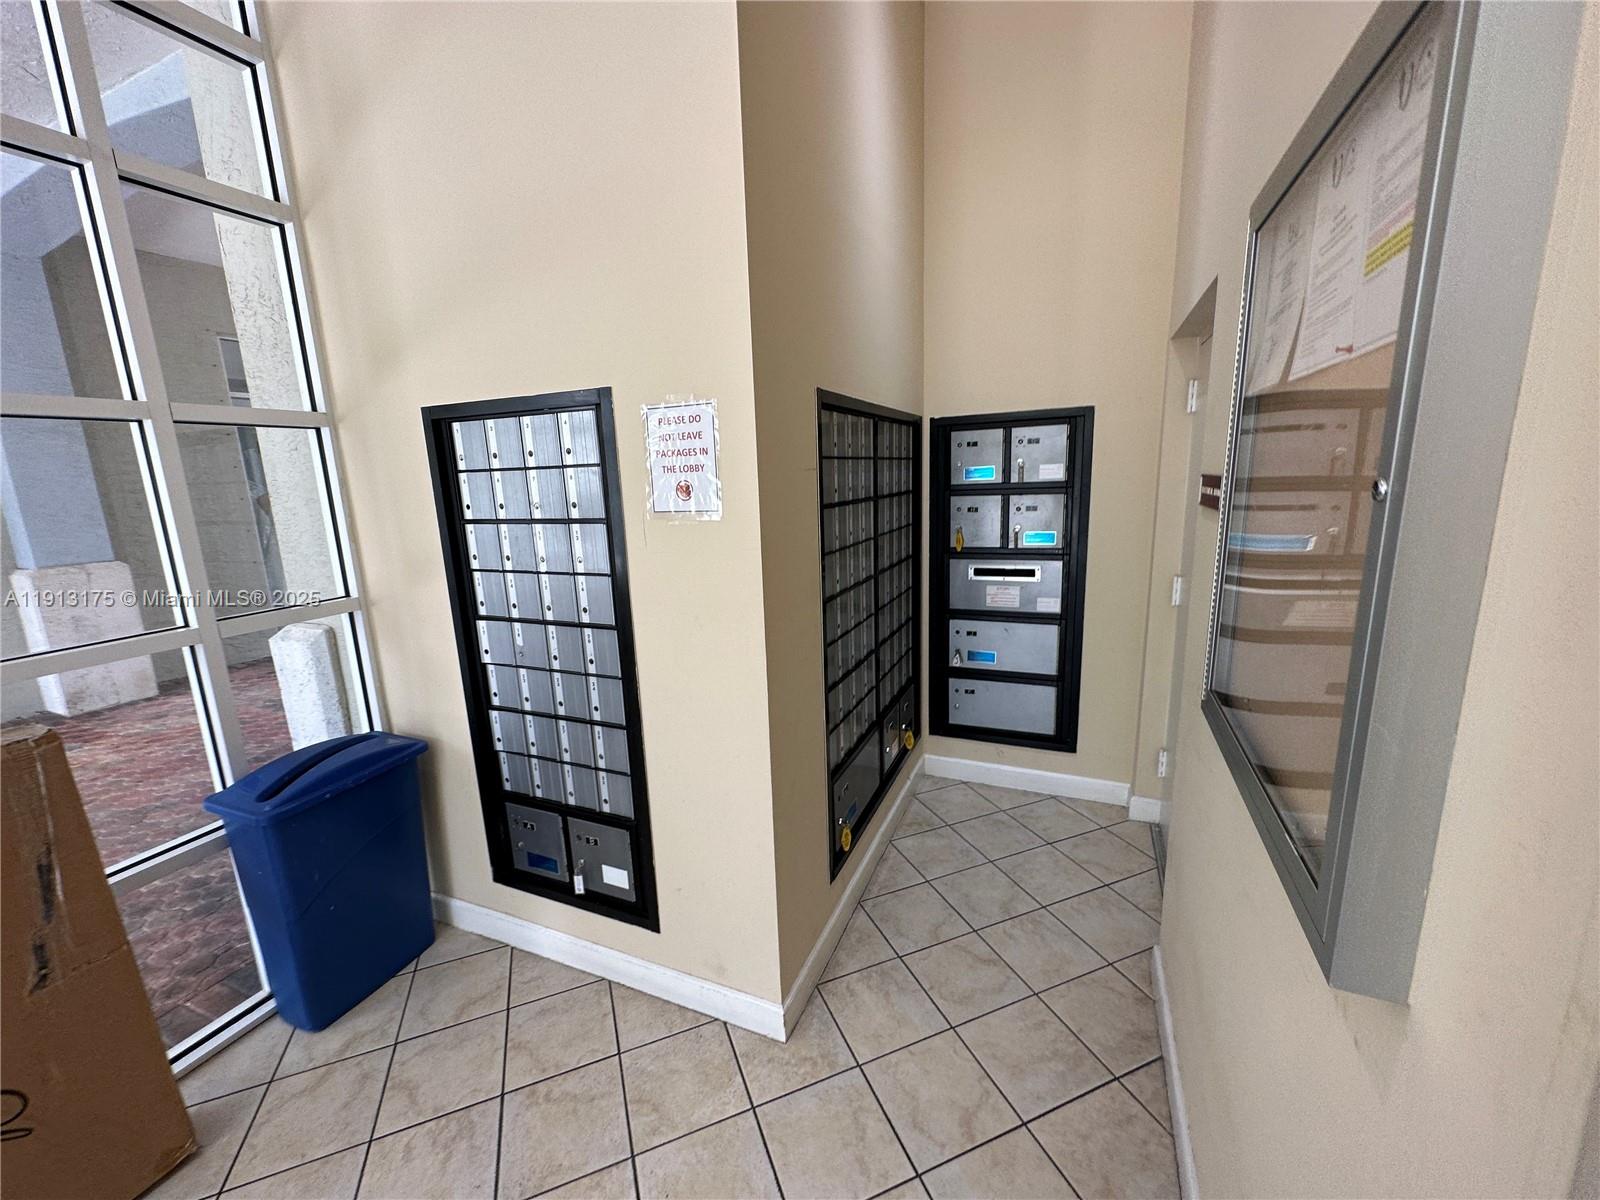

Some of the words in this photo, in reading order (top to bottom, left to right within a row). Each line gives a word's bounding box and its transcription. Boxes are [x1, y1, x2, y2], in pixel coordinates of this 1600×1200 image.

[658, 415, 686, 426] PLEASE
[688, 414, 701, 423] DO
[658, 433, 675, 442] NOT
[677, 431, 703, 441] LEAVE
[656, 448, 697, 458] PACKAGES
[699, 447, 708, 456] IN
[662, 465, 677, 474] THE
[679, 464, 705, 473] LOBBY
